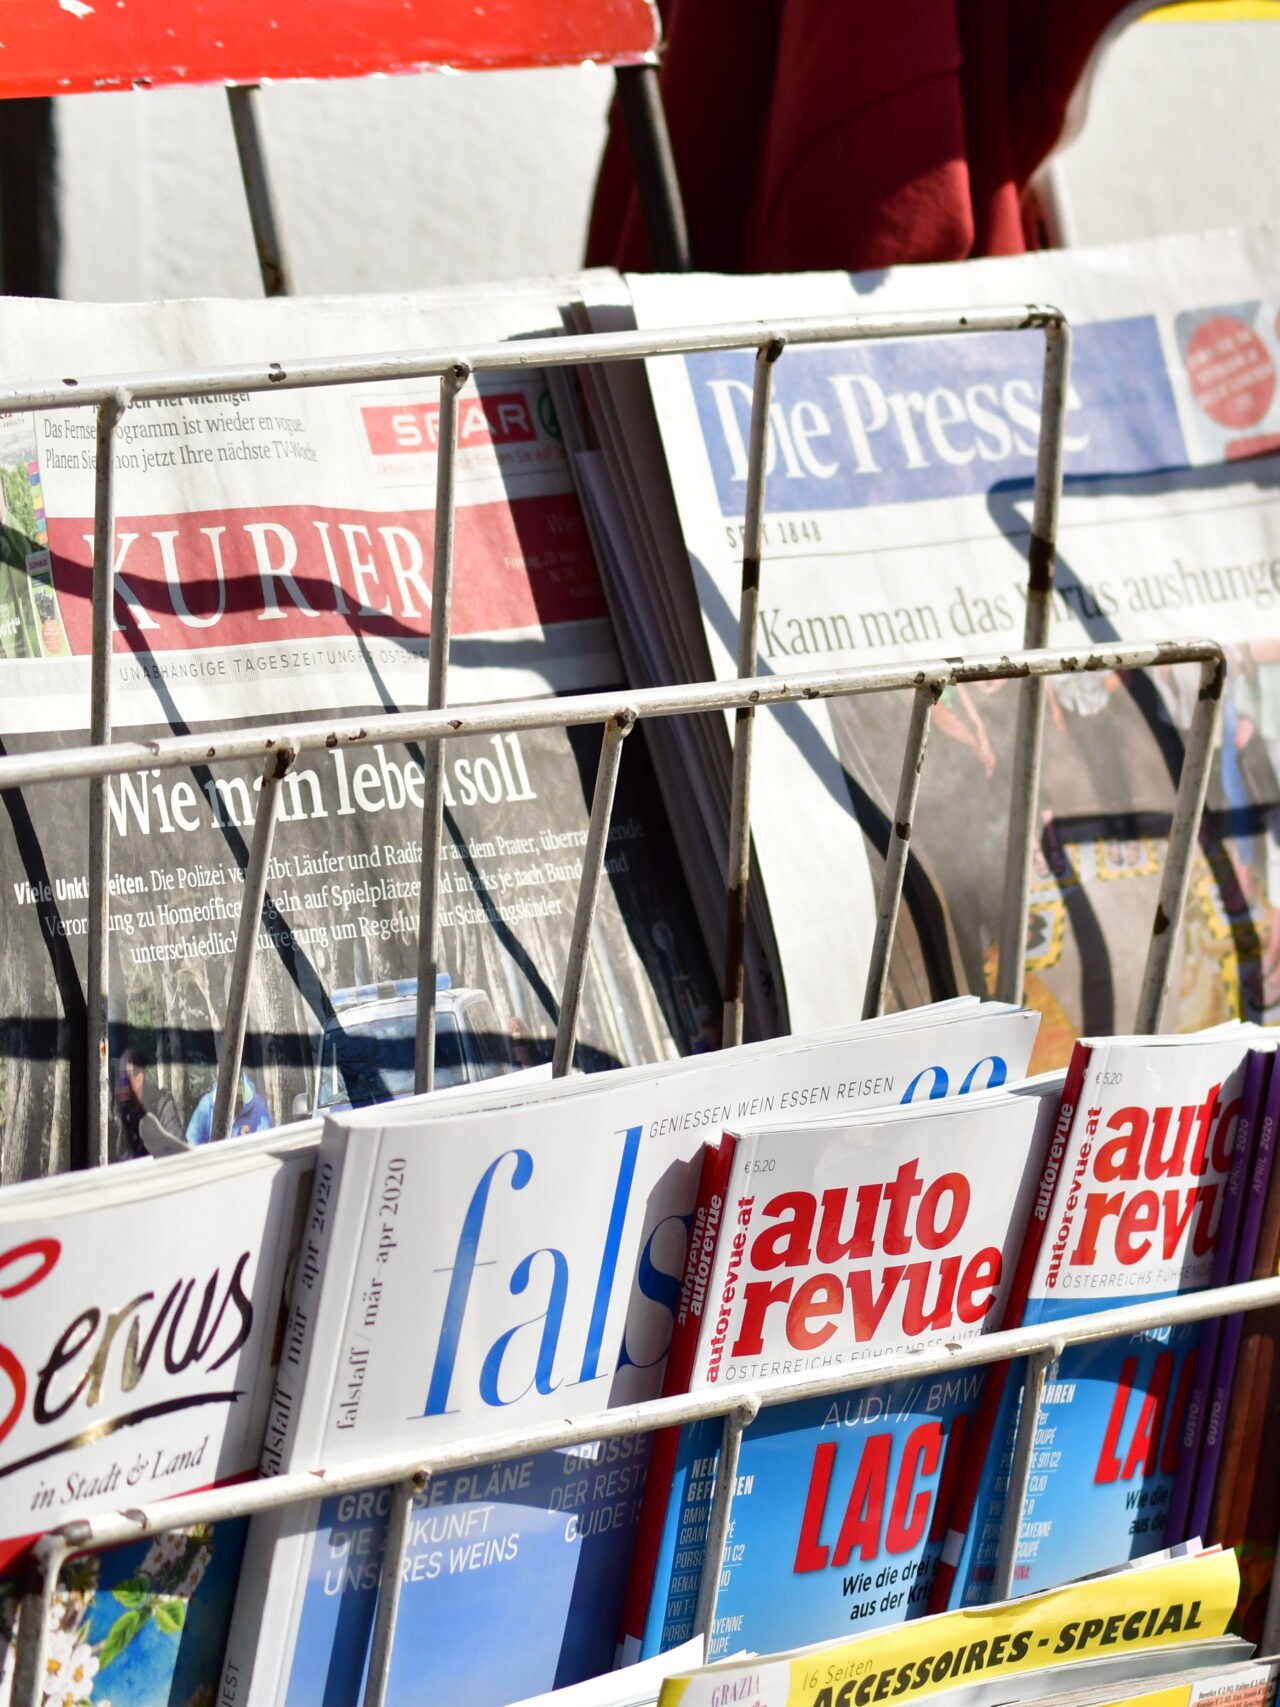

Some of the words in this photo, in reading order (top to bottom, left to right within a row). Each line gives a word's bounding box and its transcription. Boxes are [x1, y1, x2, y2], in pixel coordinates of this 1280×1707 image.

[44, 418, 62, 439] Das
[65, 415, 180, 444] Fernseogramm
[182, 414, 202, 436] ist
[205, 411, 255, 433] wieder
[258, 417, 274, 430] en
[706, 378, 839, 482] Die
[46, 449, 78, 469] Planen
[82, 449, 98, 469] Sie
[142, 448, 175, 475] jetzt
[181, 444, 213, 464] Ihre
[218, 441, 271, 463] nächste
[778, 519, 823, 544] 1848
[82, 520, 434, 632] KURIER
[759, 608, 856, 658] Kann
[859, 605, 942, 648] man
[948, 587, 1014, 637] das
[118, 658, 227, 684] UNABHÄNGIGE
[233, 648, 357, 675] TAGESZEITUNG
[108, 768, 200, 837] Wie
[455, 732, 537, 806] soll
[14, 879, 52, 906] Viele
[55, 873, 149, 902] Unkleiten.
[151, 869, 173, 892] Die
[177, 864, 225, 889] Polizei
[293, 850, 344, 876] Läufer
[350, 847, 380, 870] und
[468, 841, 495, 859] dem
[137, 909, 156, 928] zu
[305, 886, 328, 910] auf
[454, 872, 468, 892] in
[514, 864, 544, 887] nach
[332, 920, 357, 942] um
[1103, 1072, 1123, 1086] 5,20
[649, 1106, 730, 1139] GENIESSEN
[737, 1094, 774, 1119] WEIN
[780, 1084, 830, 1110] ESSEN
[836, 1075, 896, 1100] REISEN
[1260, 1116, 1273, 1151] 2020
[753, 1158, 776, 1174] 5,20
[1034, 1103, 1074, 1221] autorevue
[312, 1162, 334, 1234] 2020
[750, 1157, 972, 1272] auto
[1045, 1105, 1103, 1289] autorevue.at
[690, 1193, 722, 1317] autorevue
[336, 1346, 370, 1431] falstaff
[380, 1157, 408, 1218] 2020
[706, 1194, 756, 1384] autorevue.at
[1062, 1270, 1153, 1289] ÖSTERREICHS
[731, 1246, 1004, 1358] revue
[725, 1353, 843, 1381] ÖSTERREICHS
[821, 1392, 892, 1431] AUDI
[926, 1374, 986, 1412] BMW
[563, 1430, 648, 1476] GROSSE
[30, 1480, 55, 1513] in
[59, 1460, 120, 1505] Stadt
[152, 1435, 209, 1482] Land
[337, 1478, 448, 1523] GROSE
[453, 1460, 535, 1505] PLÄNE
[1029, 1475, 1048, 1492] CLIO
[548, 1479, 589, 1515] DER
[683, 1505, 707, 1526] BMW
[1125, 1488, 1148, 1511] Wie
[564, 1501, 627, 1544] GUIDE
[680, 1526, 705, 1546] GRAN
[1129, 1517, 1148, 1536] aus
[323, 1549, 441, 1597] UNSRES
[448, 1532, 519, 1574] WEINS
[330, 1531, 374, 1561] DIE
[733, 1544, 746, 1562] C2
[842, 1576, 872, 1598] Wie
[876, 1568, 897, 1590] die
[901, 1559, 931, 1584] drei
[710, 1614, 745, 1634] AYENNE
[850, 1599, 876, 1622] aus
[881, 1591, 905, 1614] der
[711, 1673, 762, 1707] GRAZIA
[802, 1671, 819, 1691] 16
[826, 1659, 873, 1685] Seiten
